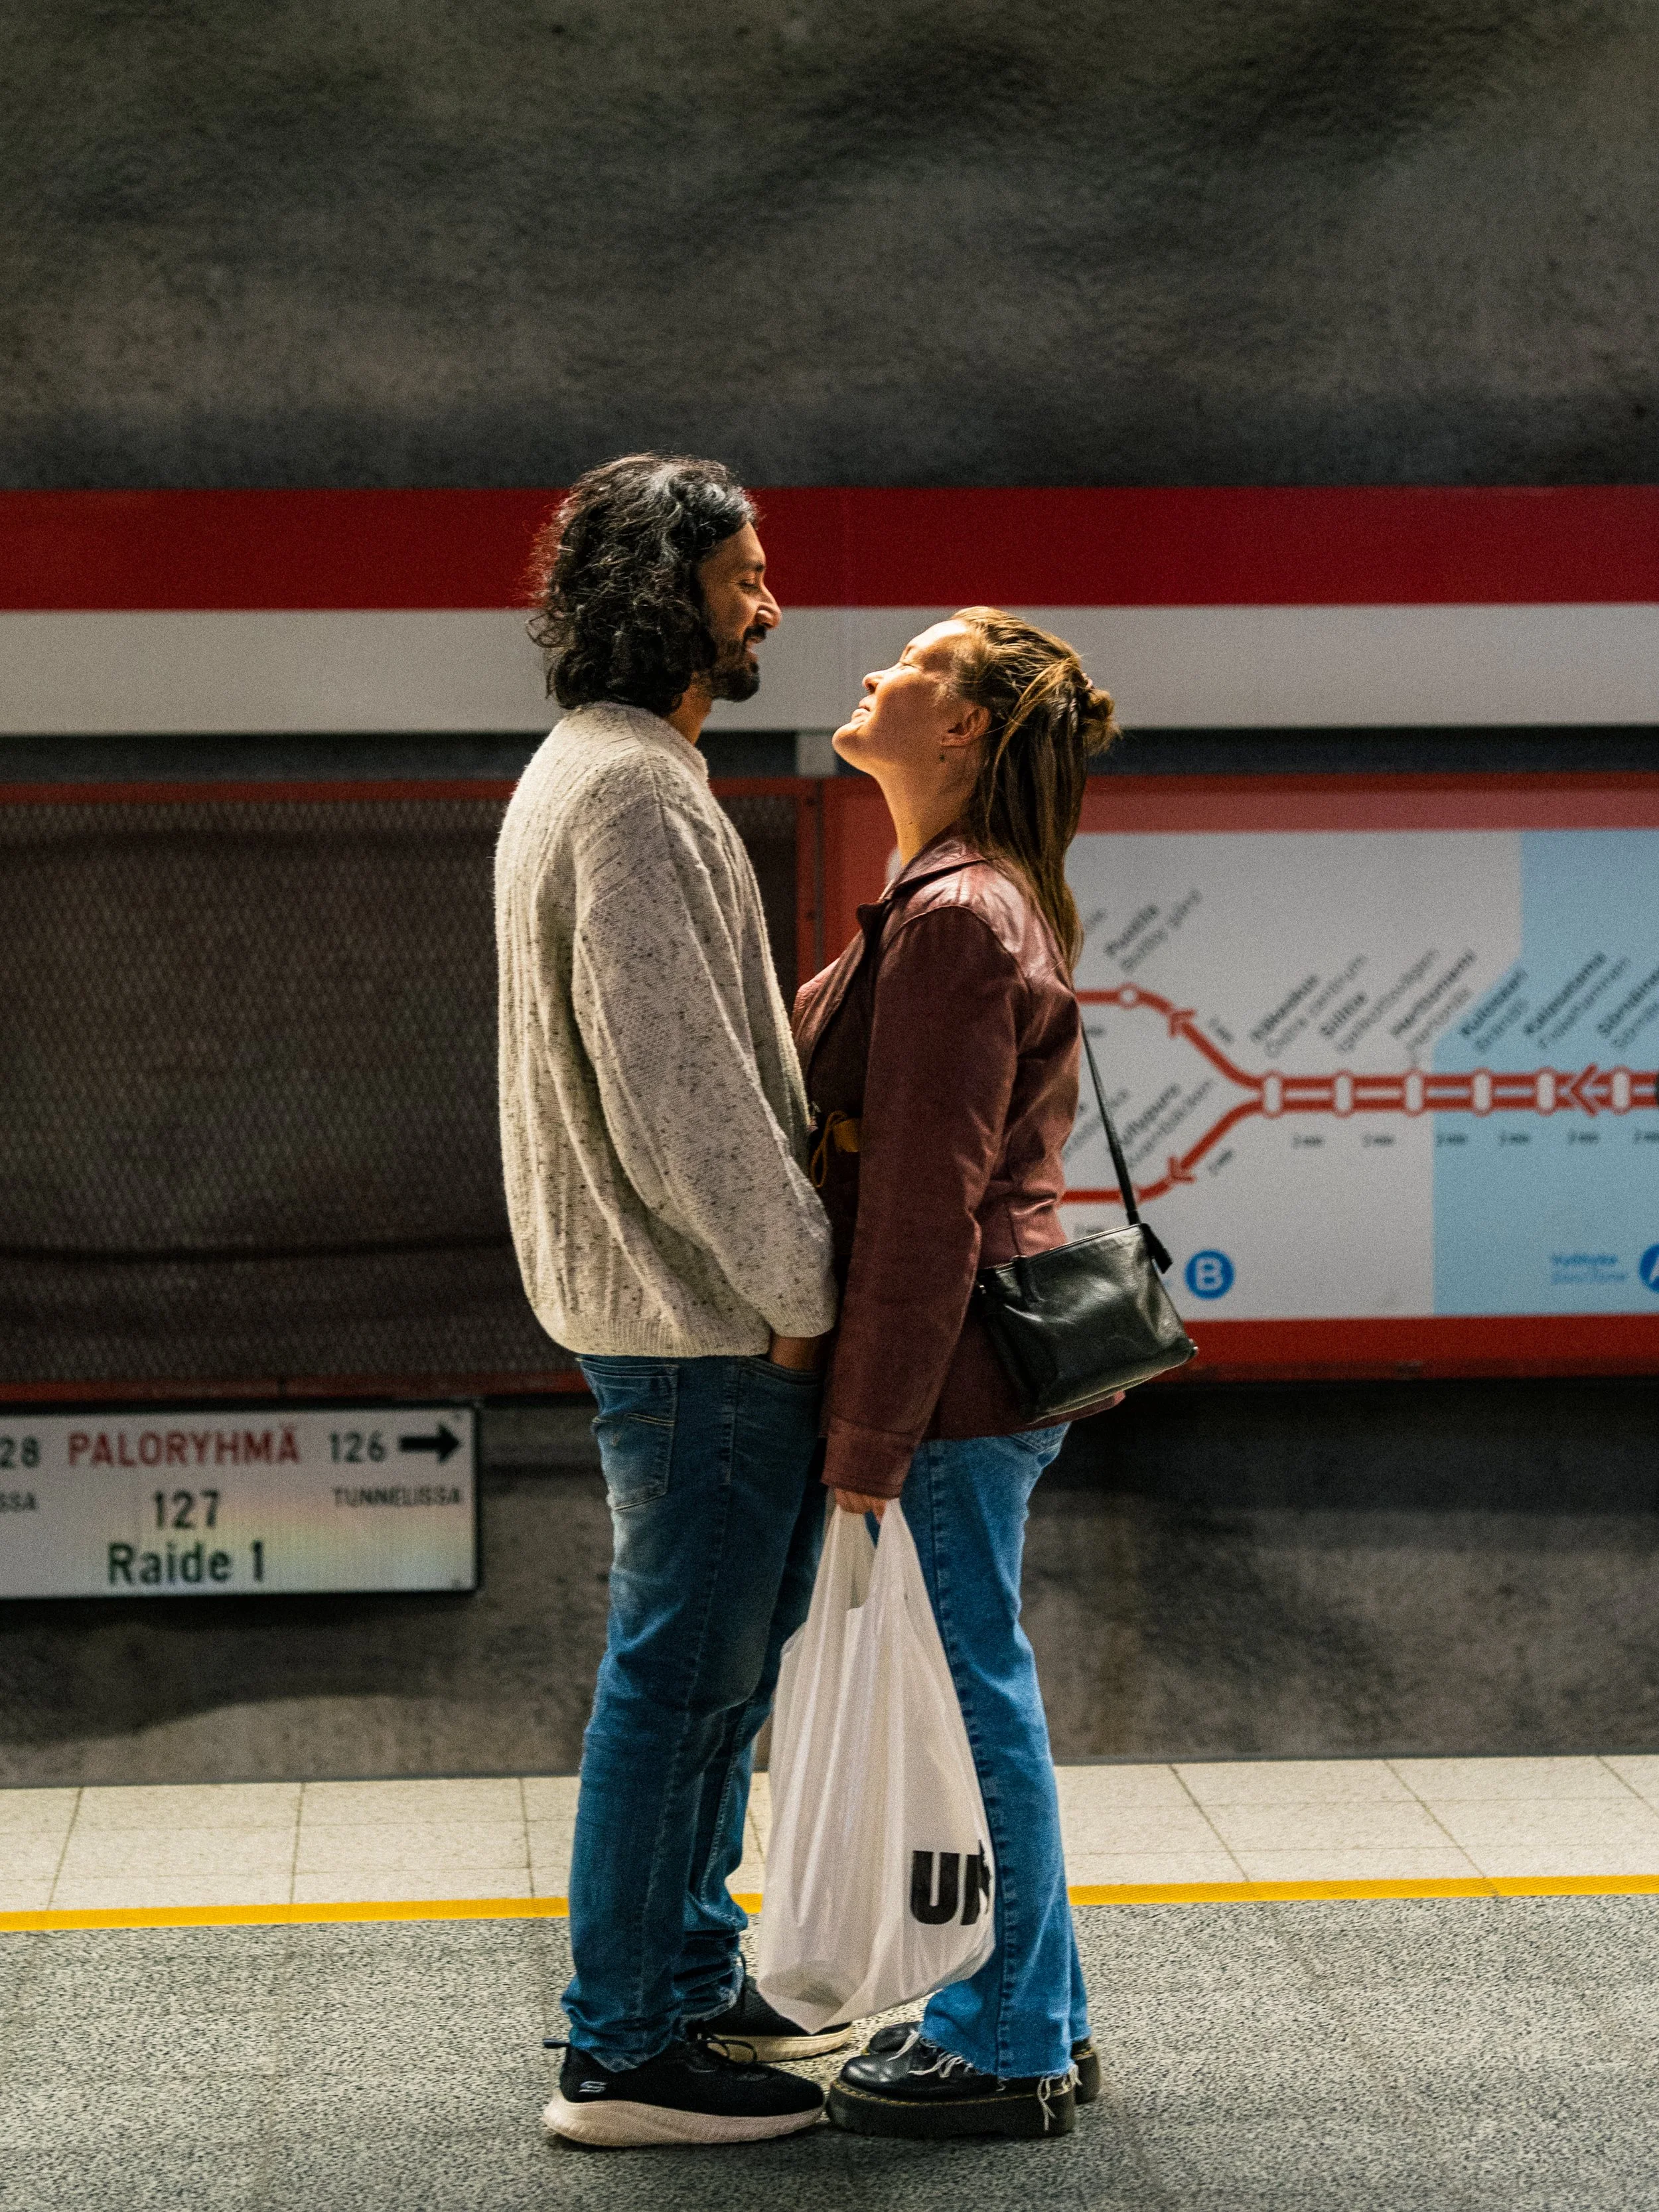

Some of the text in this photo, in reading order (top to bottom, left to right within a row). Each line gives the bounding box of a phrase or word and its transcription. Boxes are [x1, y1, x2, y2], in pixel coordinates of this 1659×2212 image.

[1195, 1260, 1224, 1291] B
[68, 1425, 301, 1467] PALORYHMÄ
[330, 1430, 387, 1463] 126
[153, 1490, 221, 1530] 127
[332, 1486, 461, 1508] TUNNELISSA
[108, 1540, 265, 1585] Raide 1
